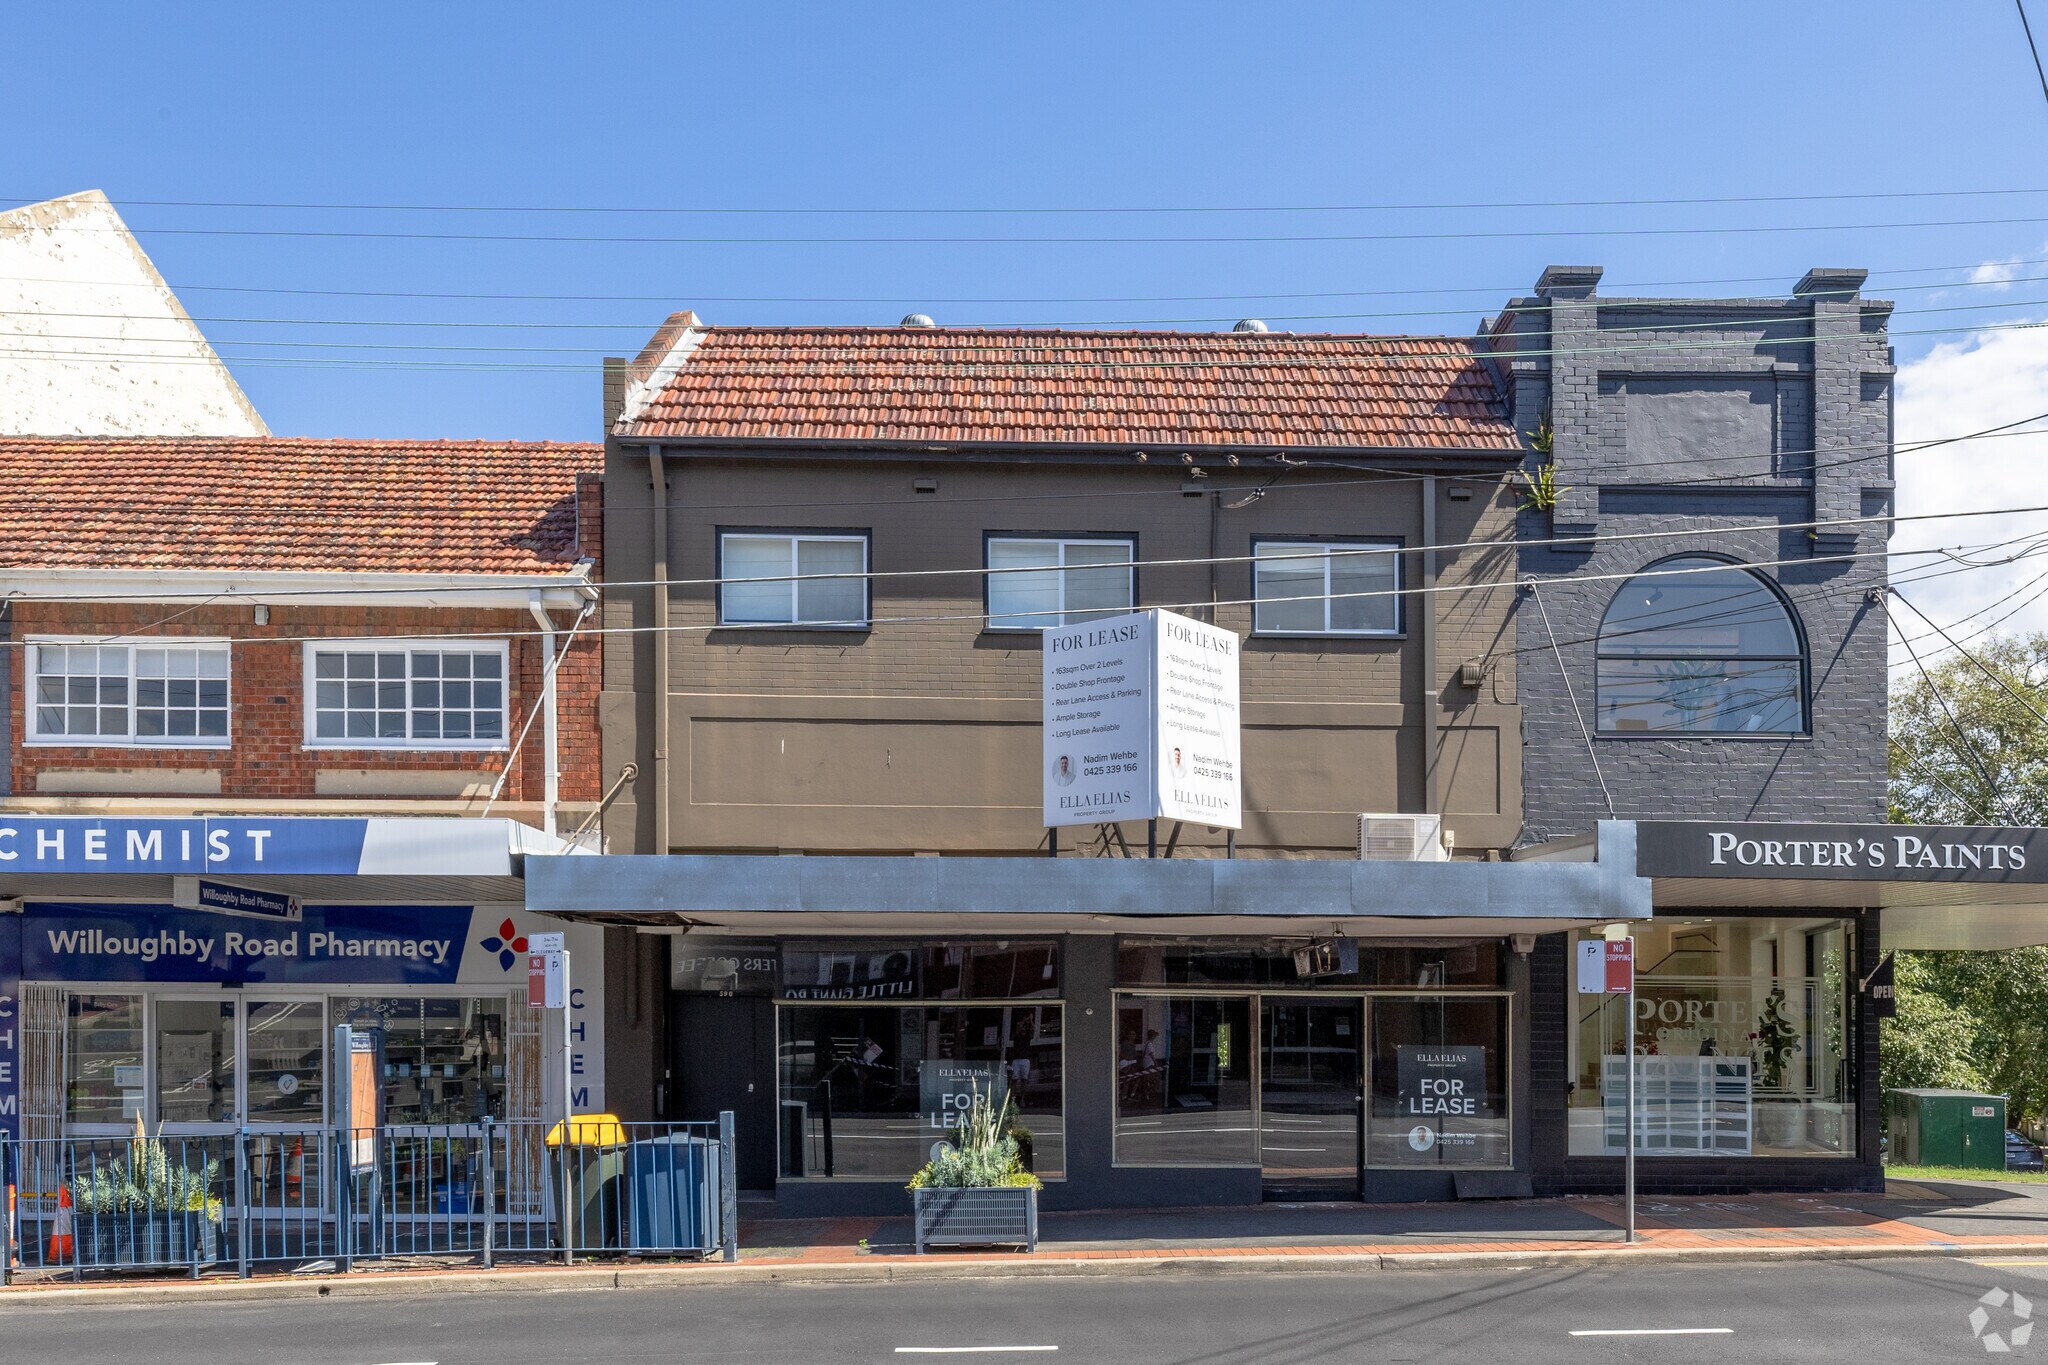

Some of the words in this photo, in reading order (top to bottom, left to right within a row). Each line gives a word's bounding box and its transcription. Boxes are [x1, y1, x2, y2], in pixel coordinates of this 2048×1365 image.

[1053, 635, 1083, 652] FOR
[1089, 624, 1139, 647] LEASE
[1168, 622, 1191, 644] FOR
[1196, 632, 1232, 655] LEASE
[1056, 666, 1079, 675] 163sqm
[1080, 663, 1095, 671] Over
[1102, 658, 1123, 668] Levels
[1190, 660, 1201, 668] Over
[1207, 664, 1221, 675] Levels
[1056, 682, 1078, 690] Double
[1079, 679, 1095, 687] Shop
[1096, 674, 1125, 684] Frontage
[1170, 670, 1188, 681] Double
[1189, 676, 1201, 685] Shop
[1202, 679, 1223, 692] Frontage
[1087, 694, 1109, 702] Access
[1117, 688, 1142, 697] Parking
[1170, 687, 1181, 695] Rear
[1182, 690, 1194, 699] Lane
[1196, 693, 1212, 704] Access
[1218, 699, 1234, 711] Parking
[1056, 713, 1075, 722] Ample
[1077, 710, 1101, 719] Storage
[1170, 704, 1186, 714] Ample
[1187, 707, 1206, 719] Storage
[1056, 730, 1071, 738] Long
[1092, 724, 1120, 733] Available
[1170, 720, 1183, 730] Long
[1184, 723, 1198, 732] Lease
[1199, 727, 1220, 737] Available
[1084, 753, 1108, 763] Nadim
[1110, 751, 1138, 760] Wehbe
[1193, 754, 1212, 764] Nadim
[1213, 758, 1233, 769] Wehbe
[1084, 767, 1104, 776] 0425
[1106, 765, 1121, 774] 339
[1124, 763, 1137, 772] 166
[1193, 766, 1209, 776] 0425
[1211, 770, 1222, 779] 339
[1060, 795, 1090, 808] ELLA
[1094, 791, 1131, 805] ELIAS
[1175, 789, 1199, 805] ELLA
[1202, 794, 1228, 809] ELIAS
[0, 828, 272, 862] CHEMIST
[1708, 832, 1885, 868] PORTER'S
[1893, 835, 2026, 871] PAINTS
[203, 888, 239, 906] Willoughby
[240, 894, 255, 906] Road
[257, 897, 284, 913] Pharmacy
[48, 930, 214, 962] Willoughby
[225, 932, 298, 956] Road
[310, 932, 450, 964] Pharmacy
[1613, 944, 1624, 952] NO
[533, 959, 540, 967] NO
[1874, 985, 1894, 998] OPEN
[1417, 1054, 1440, 1062] ELLA
[1421, 1079, 1464, 1095] FOR
[942, 1094, 986, 1109] FOR
[1410, 1098, 1475, 1114] LEASE
